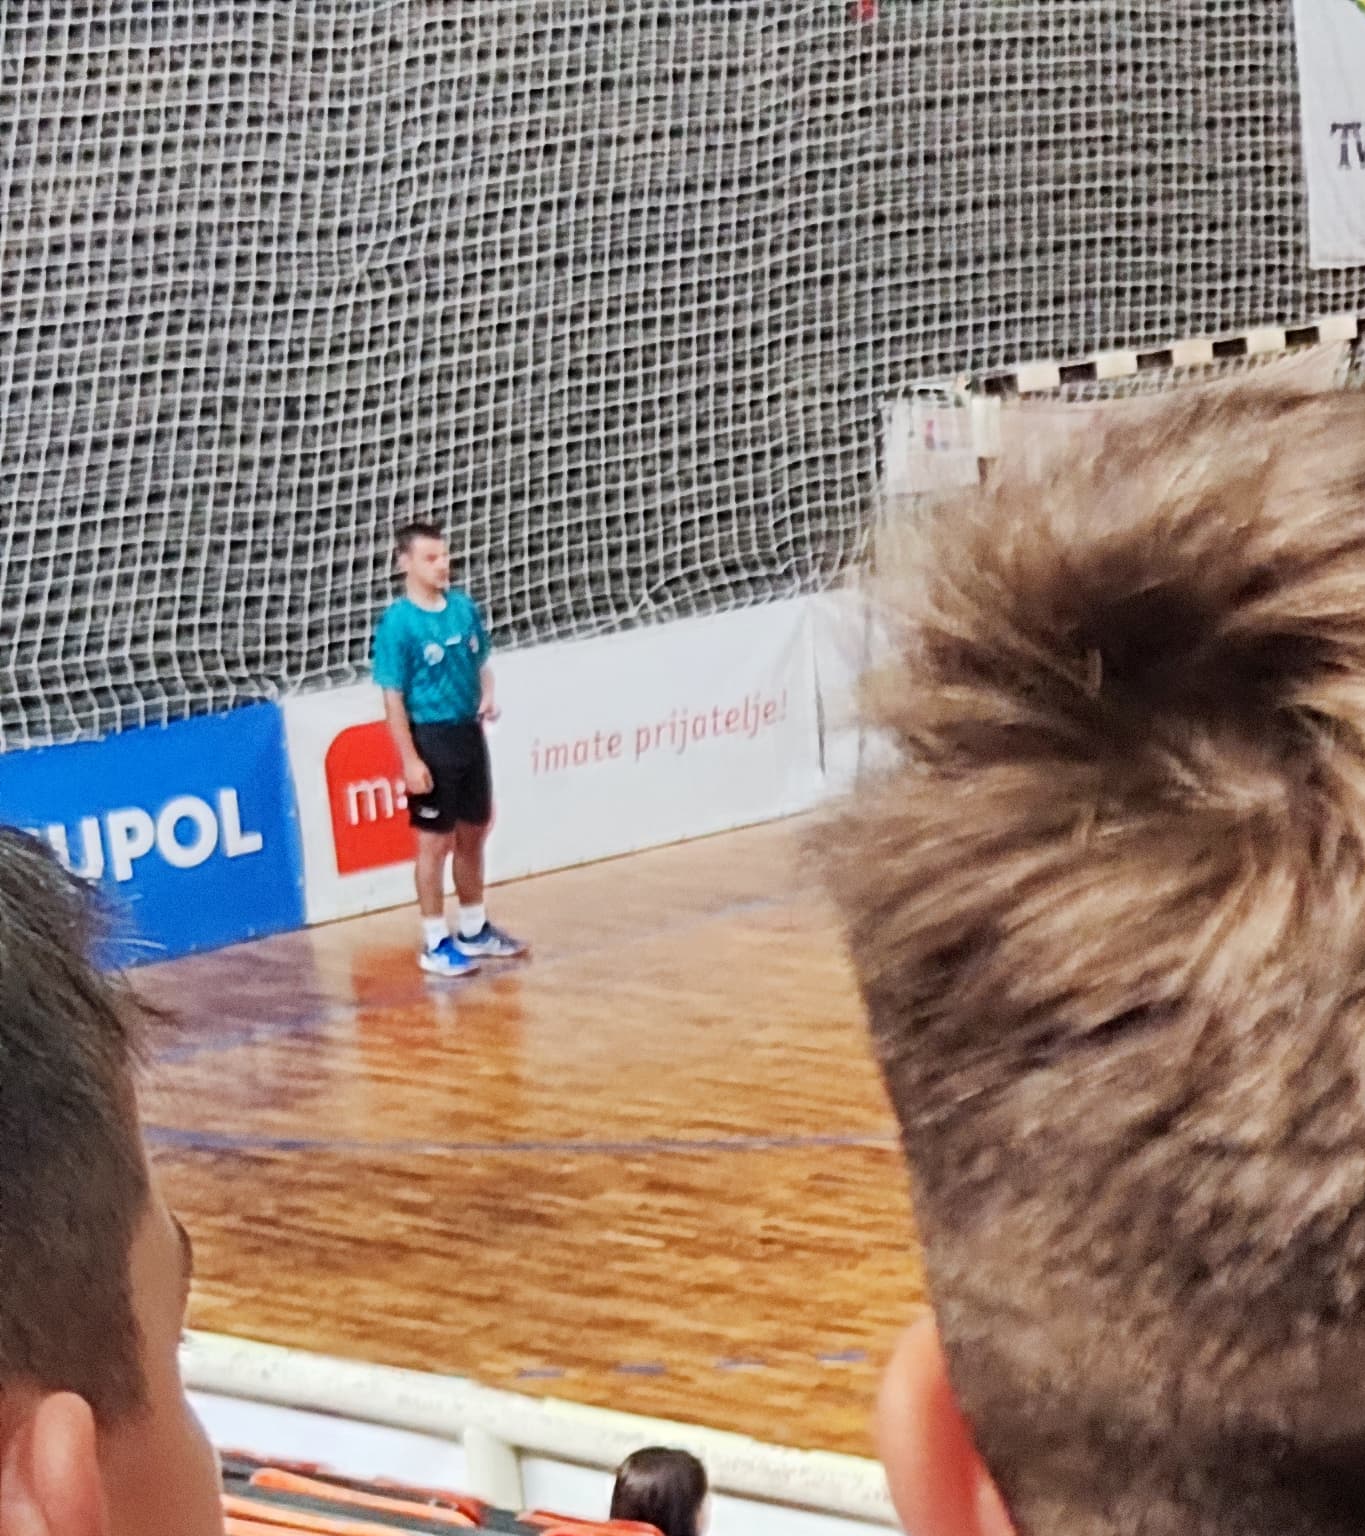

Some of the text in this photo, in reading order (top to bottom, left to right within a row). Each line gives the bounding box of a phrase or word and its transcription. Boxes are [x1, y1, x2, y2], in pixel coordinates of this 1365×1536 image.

[530, 689, 788, 776] imate prijatelje!
[28, 788, 263, 882] UPOL
